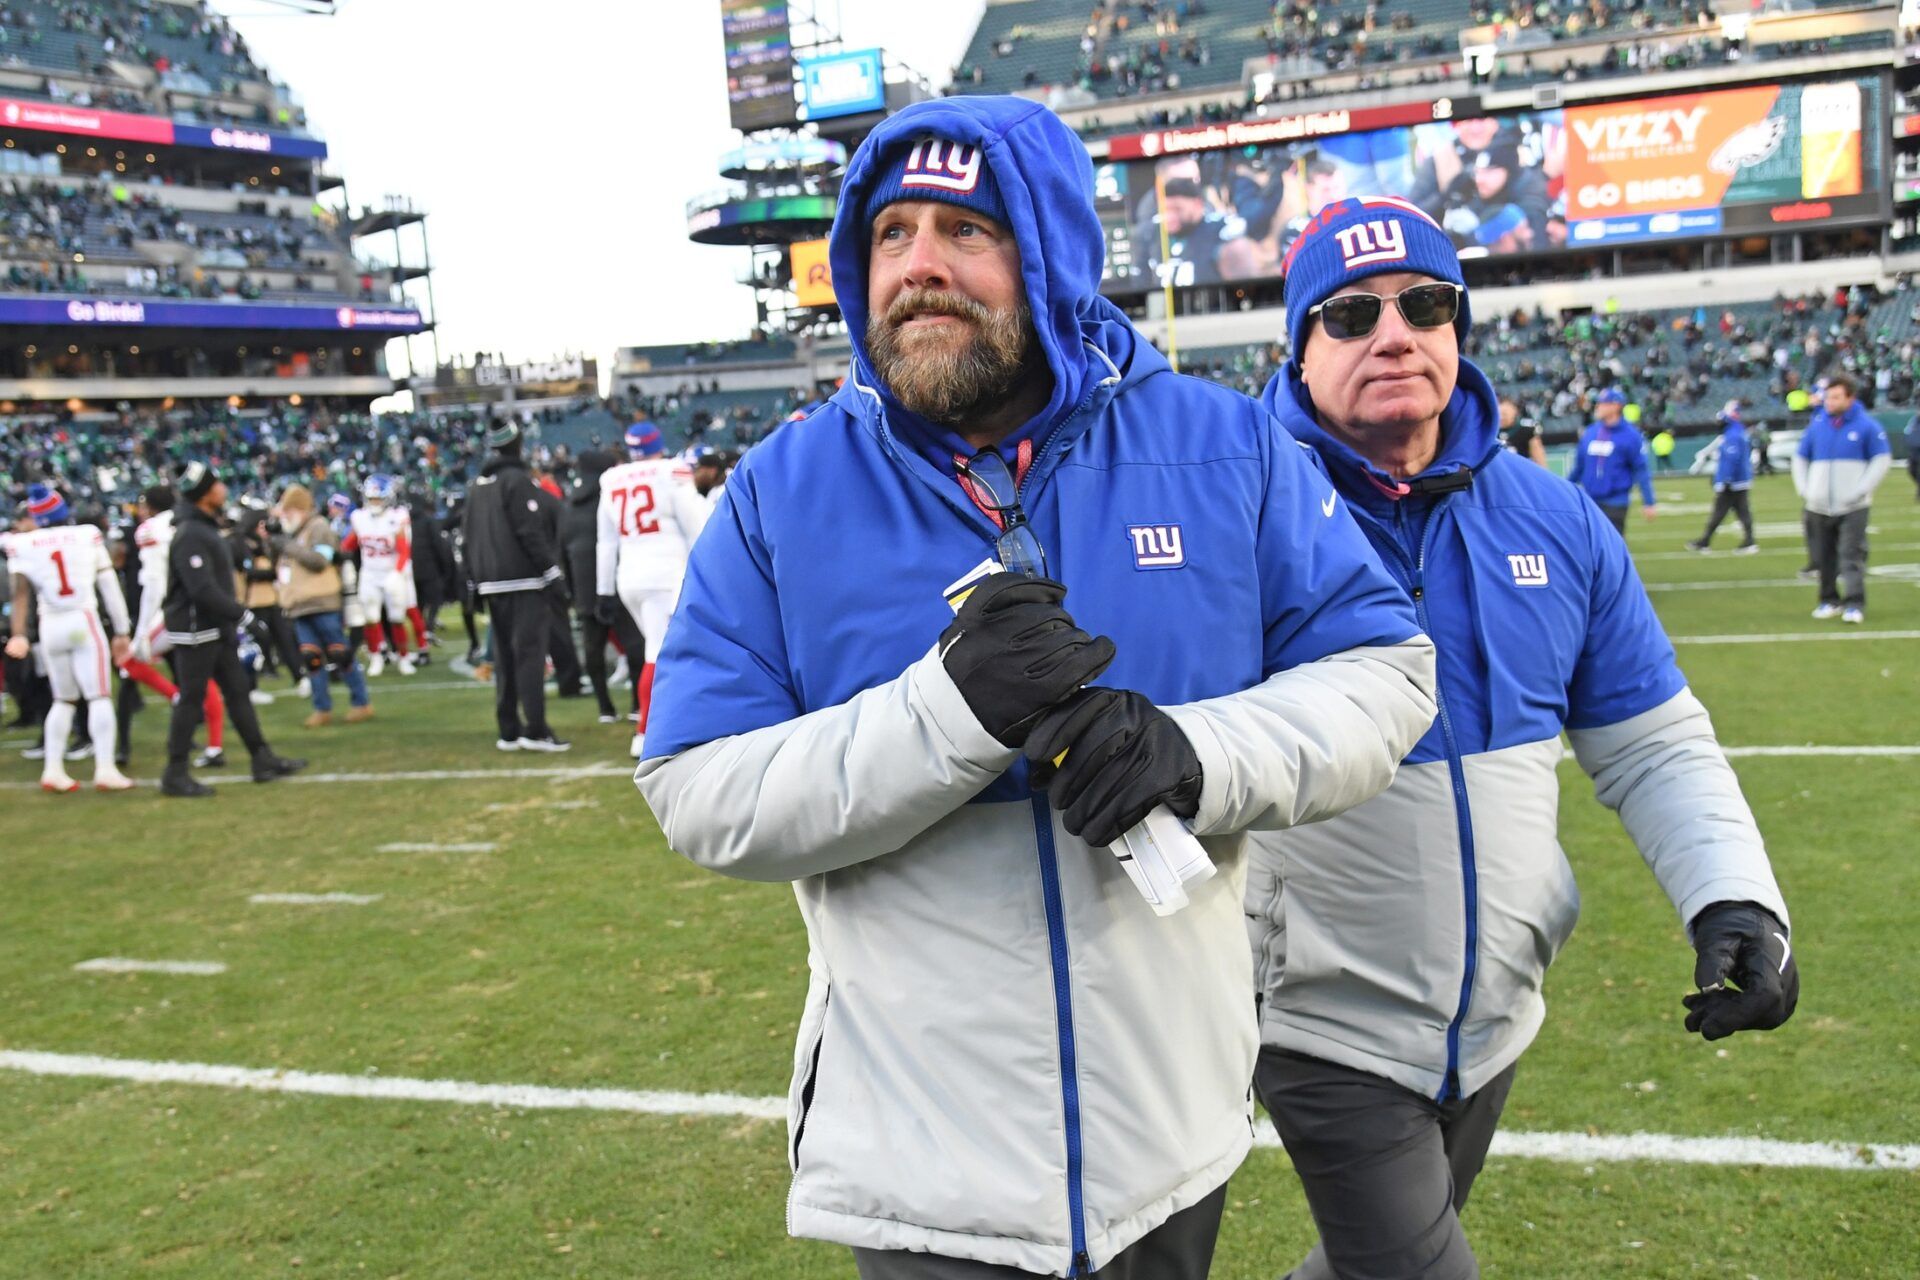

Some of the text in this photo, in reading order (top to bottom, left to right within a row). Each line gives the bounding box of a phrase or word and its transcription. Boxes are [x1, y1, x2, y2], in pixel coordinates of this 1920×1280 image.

[1163, 109, 1350, 152] Lincoln Financial Field
[1572, 106, 1710, 150] VIZZY
[1578, 174, 1704, 208] GO BIRDS
[67, 300, 93, 321] Go
[611, 484, 660, 536] 72
[51, 550, 74, 597] 1
